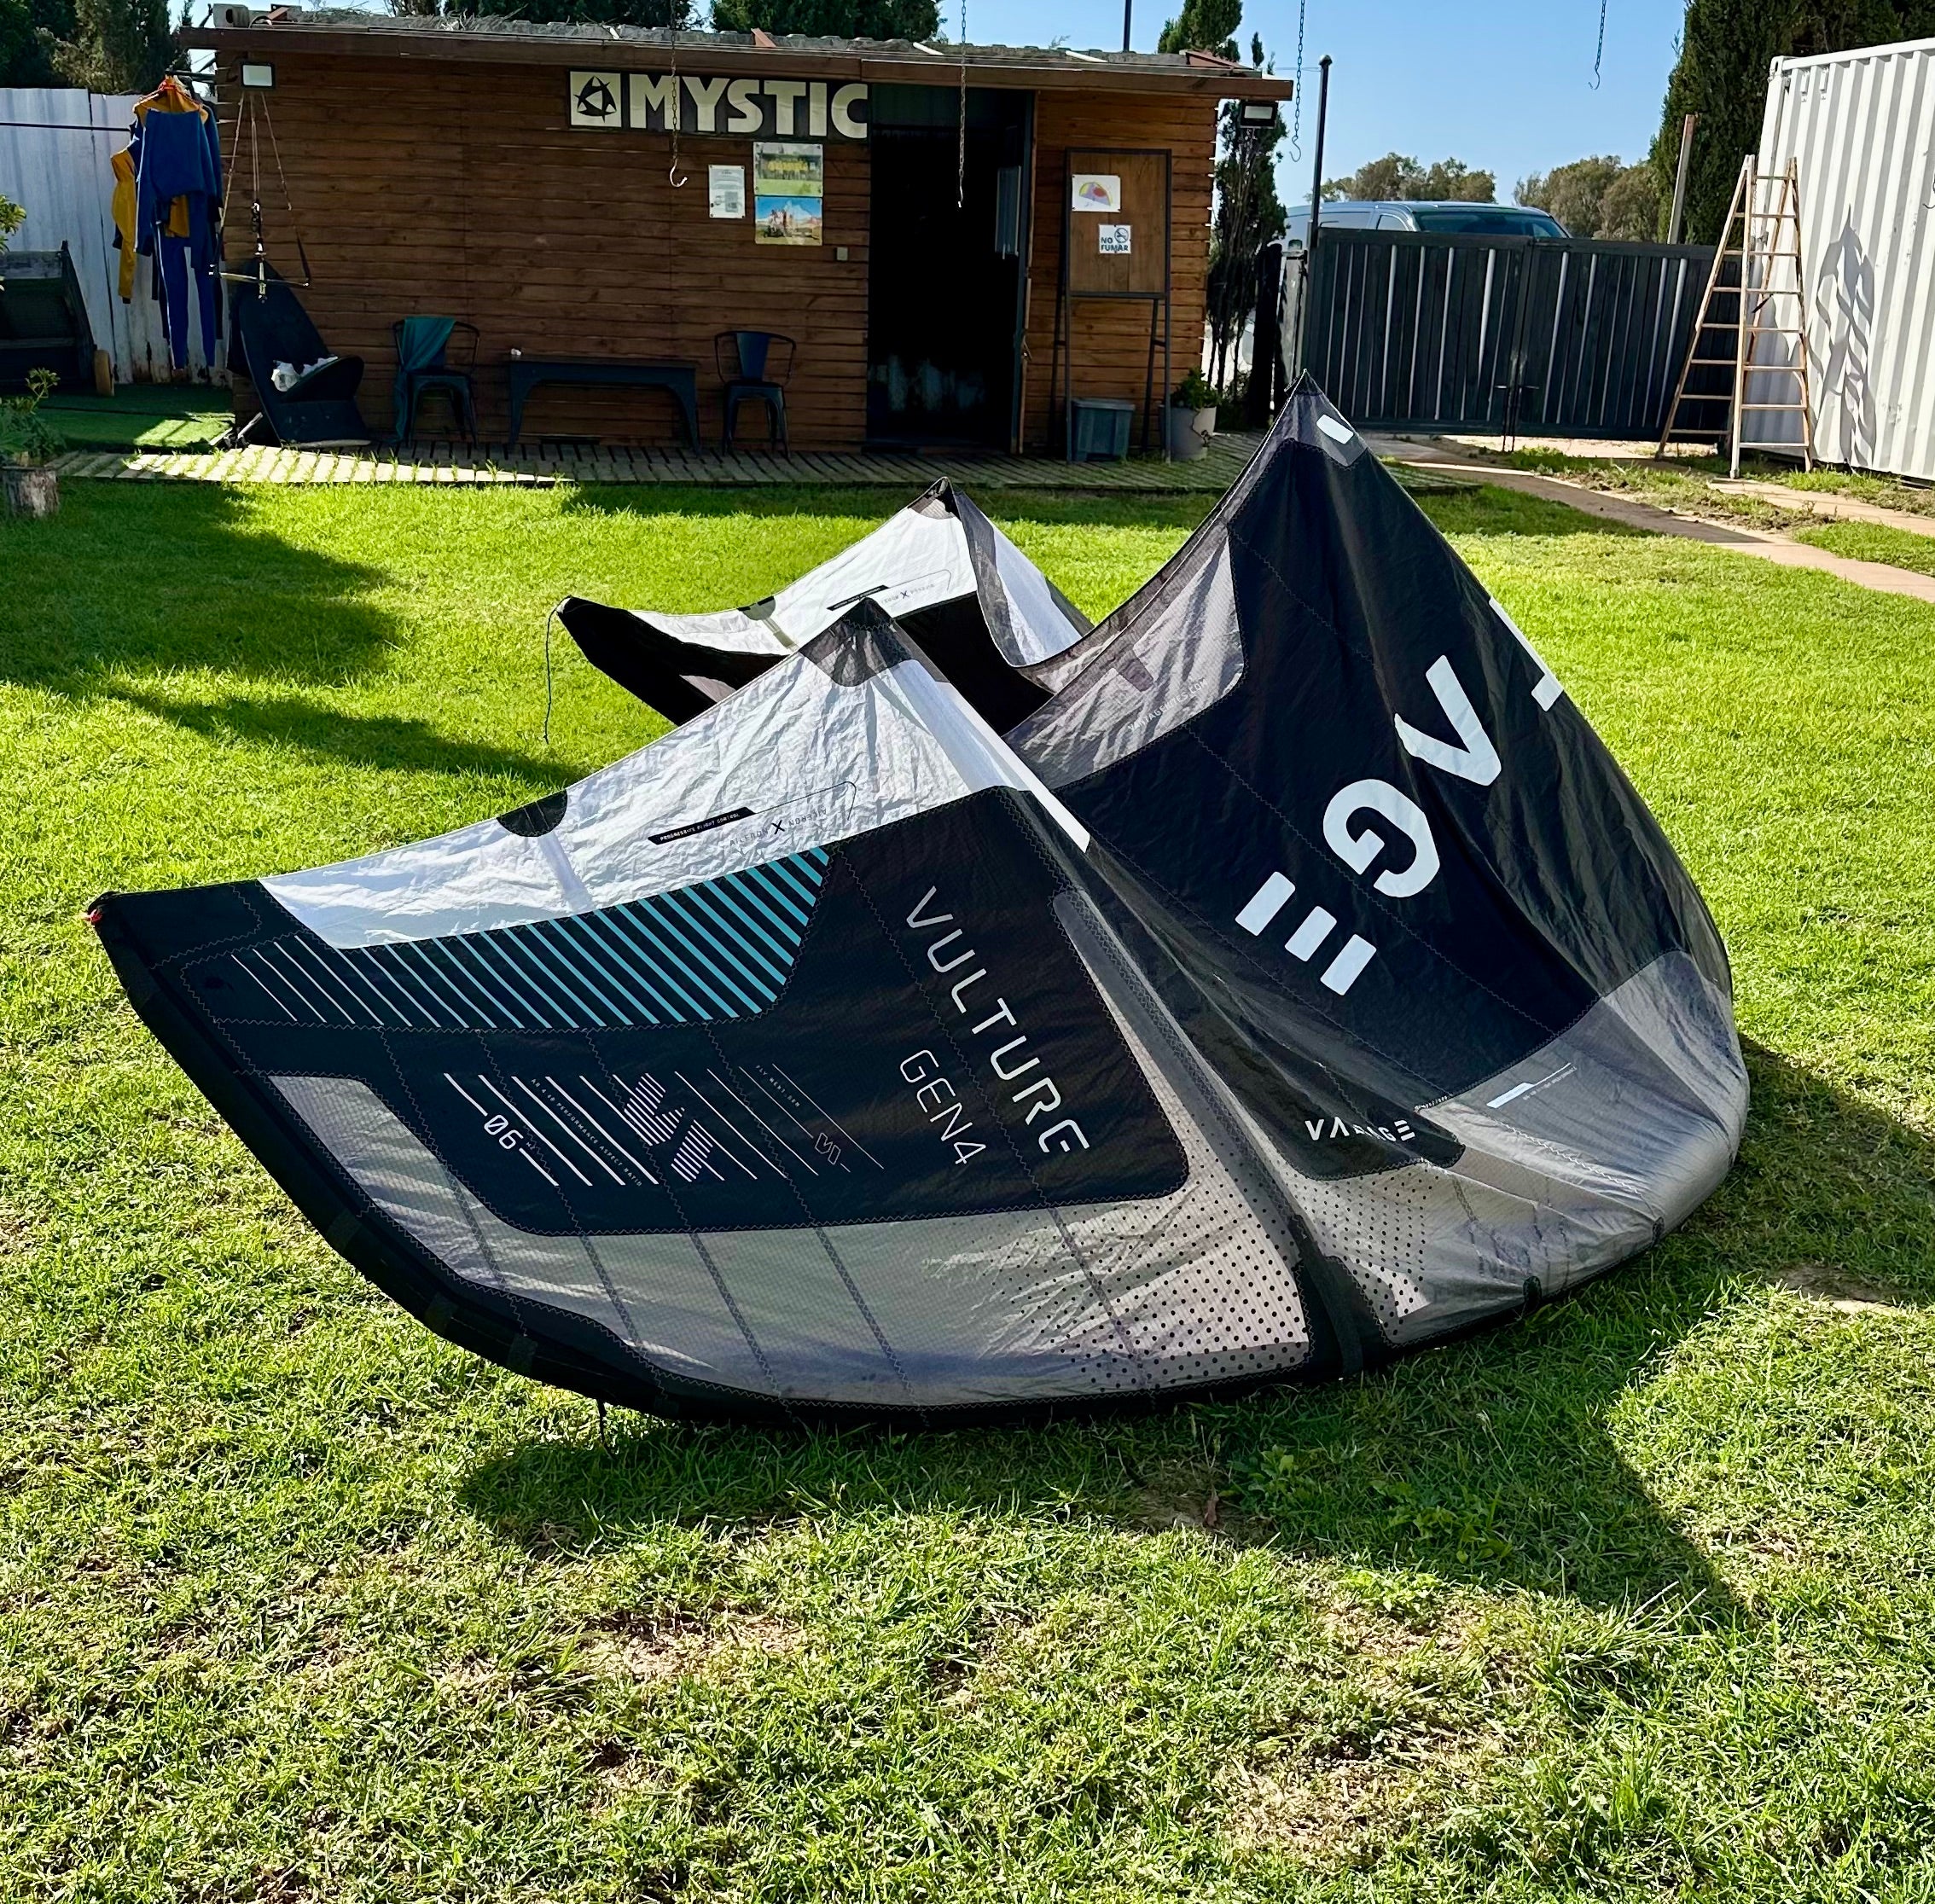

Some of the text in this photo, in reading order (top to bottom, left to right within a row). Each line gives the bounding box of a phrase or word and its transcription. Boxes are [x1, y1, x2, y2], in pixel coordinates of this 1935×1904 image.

[629, 73, 869, 139] MYSTIC
[729, 827, 769, 846] AILERON
[770, 820, 785, 835] X
[906, 885, 1090, 1153] VULTURE
[483, 1113, 524, 1150] 06
[556, 1102, 599, 1144] PERFORMANCE
[599, 1146, 623, 1166] ASPECT
[624, 1167, 642, 1187] RATIO
[900, 1049, 987, 1165] GEN4
